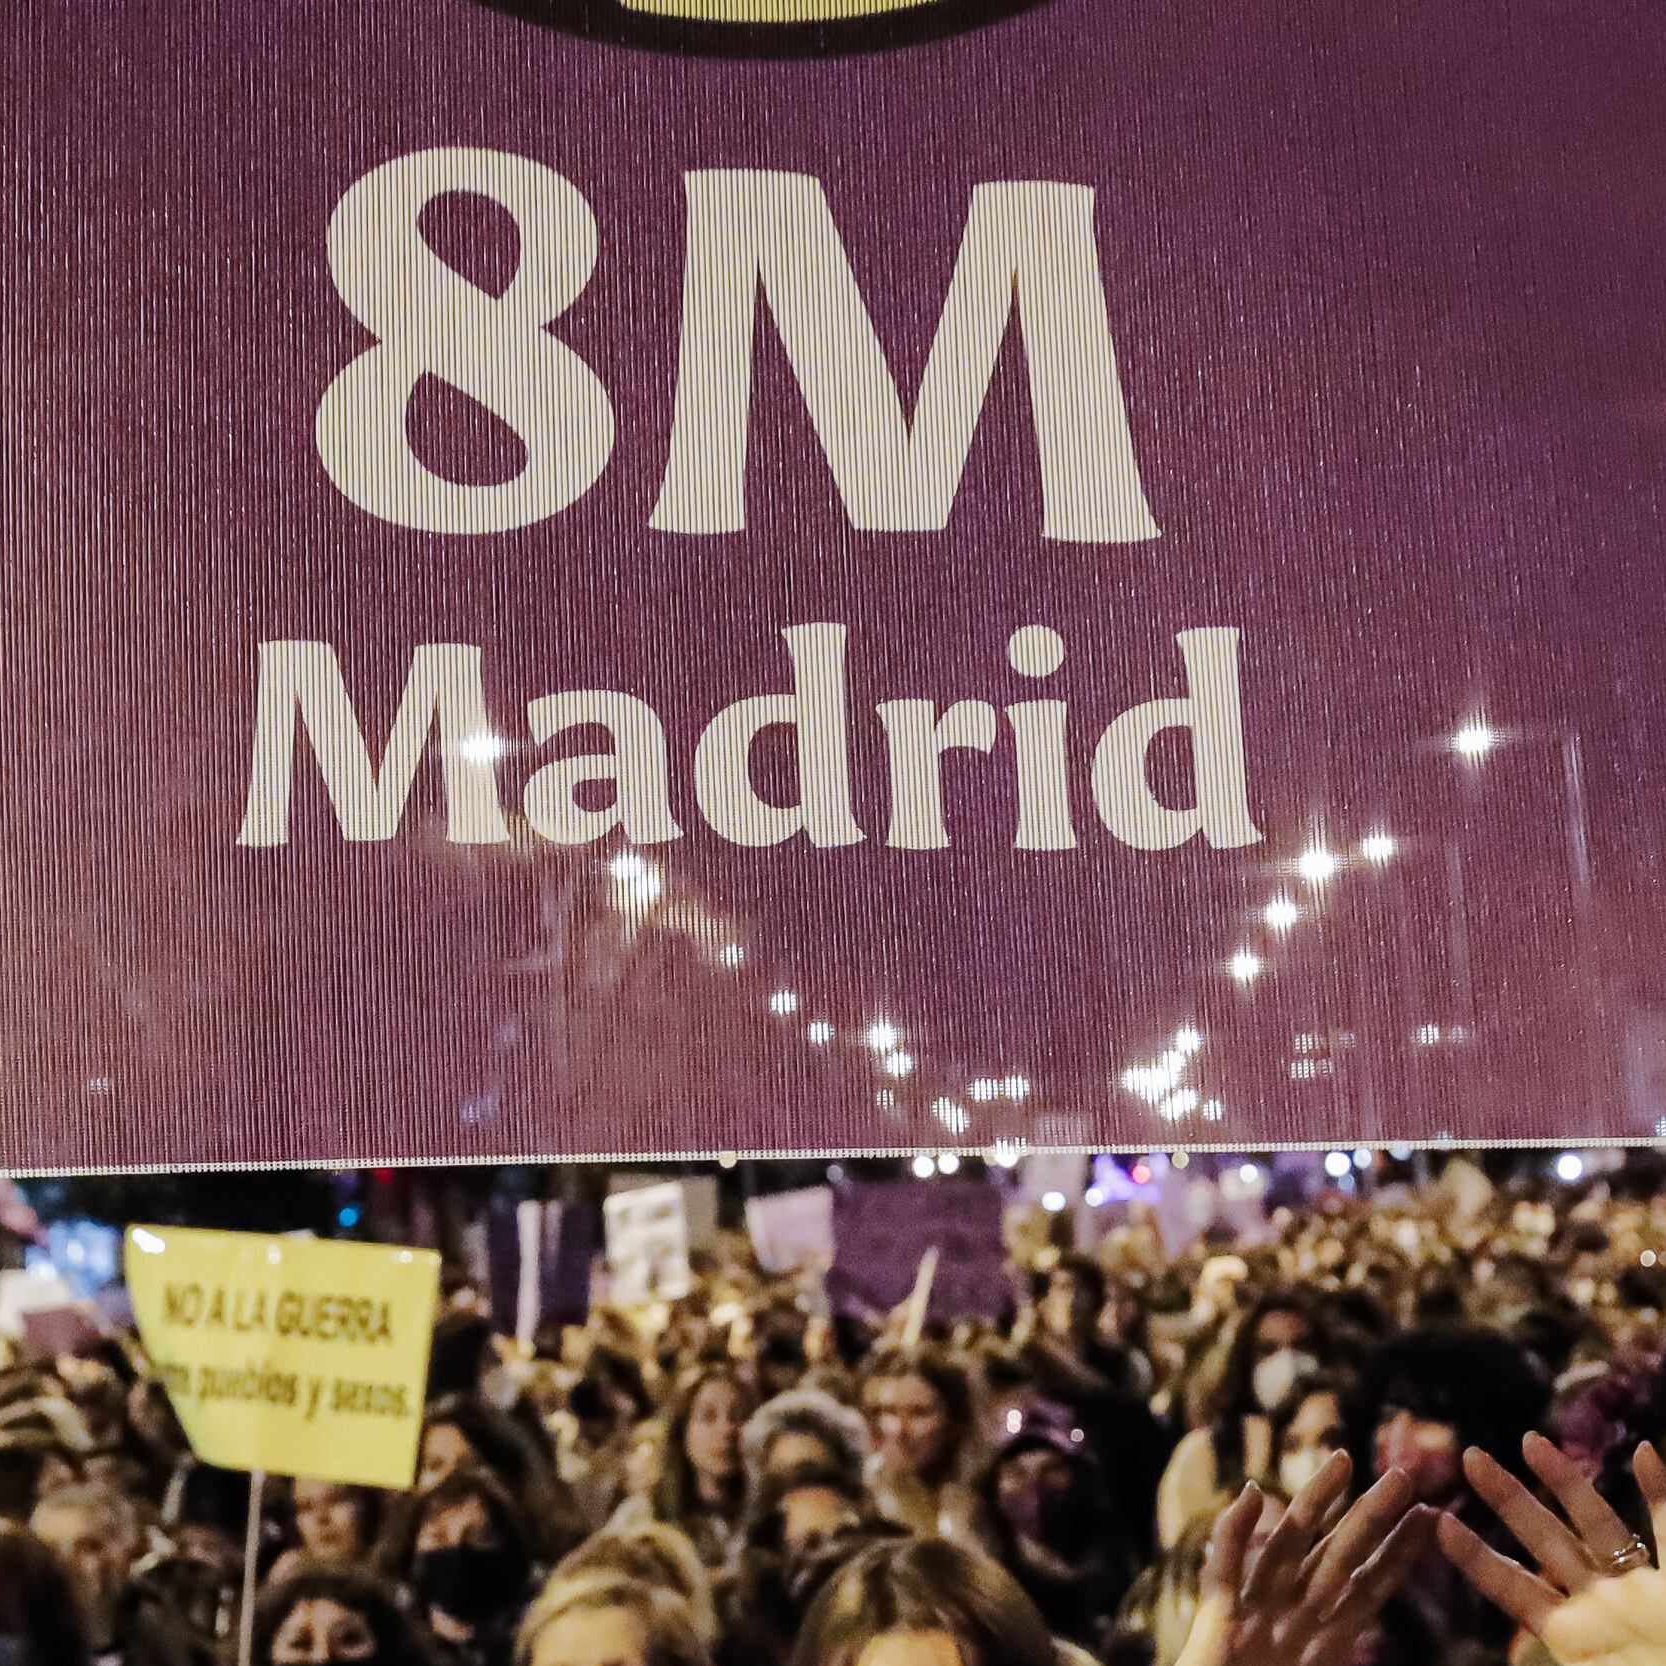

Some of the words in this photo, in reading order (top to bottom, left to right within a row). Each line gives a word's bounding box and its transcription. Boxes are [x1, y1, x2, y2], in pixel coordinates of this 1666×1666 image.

[316, 145, 1161, 543] 8M
[234, 621, 1263, 850] Madrid
[162, 1281, 202, 1328] NO
[205, 1286, 225, 1330] A
[232, 1288, 269, 1332] LA
[275, 1288, 393, 1343] GUERRA
[197, 1358, 298, 1408] pueblos
[303, 1376, 323, 1422] y
